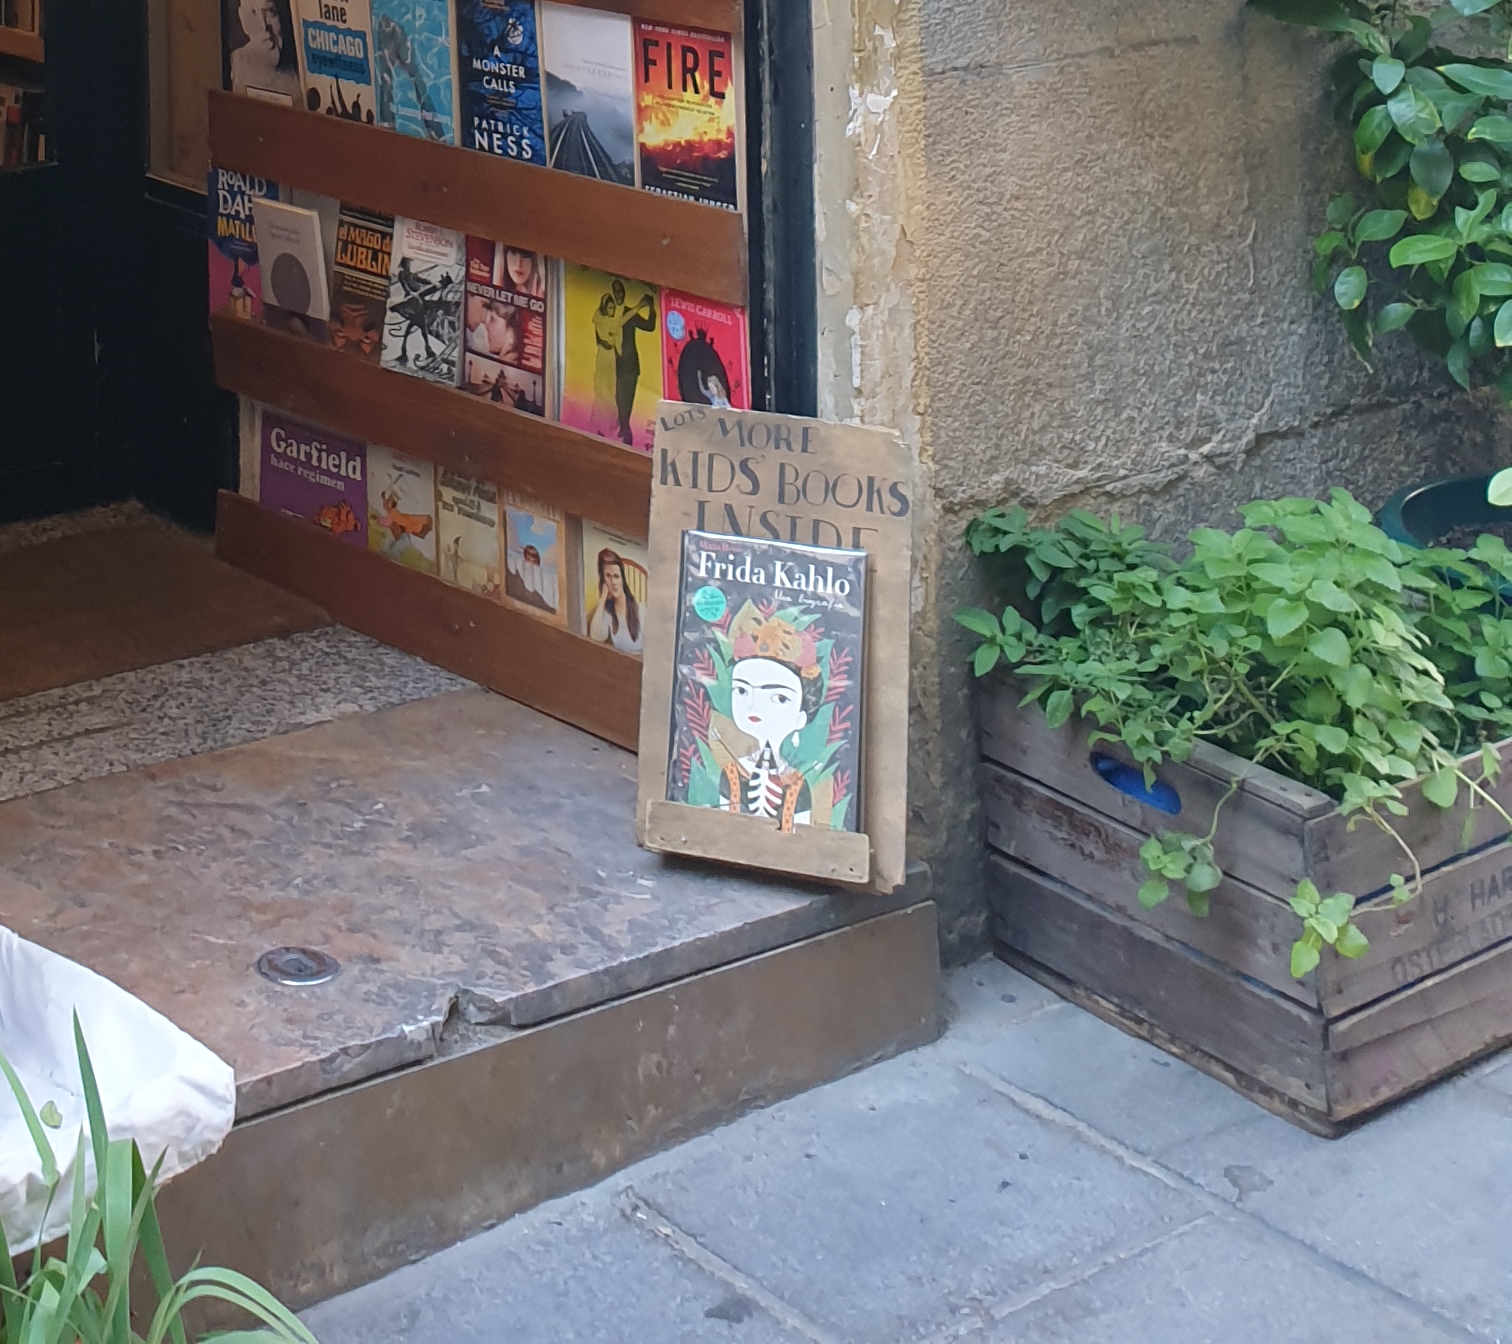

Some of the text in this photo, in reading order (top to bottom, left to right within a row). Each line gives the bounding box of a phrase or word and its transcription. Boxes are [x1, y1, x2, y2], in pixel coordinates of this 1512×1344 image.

[307, 29, 365, 59] CHICAGO
[493, 45, 501, 57] A
[472, 57, 526, 79] MONSTER
[642, 37, 727, 101] FIRE
[482, 77, 516, 94] CALLS
[473, 116, 530, 137] PATRICK
[474, 130, 533, 160] NESS
[217, 167, 267, 197] ROALD
[348, 225, 381, 251] MAGO
[404, 228, 455, 250] STEVENSON
[466, 280, 545, 313] NEVER LET ME GO
[669, 295, 733, 326] LEWIS CARROLL
[713, 416, 817, 454] MORE
[270, 427, 363, 482] Garfield
[270, 453, 296, 474] hace
[658, 446, 911, 518] KIDS' BOOKS
[698, 550, 852, 597] Frida Kahlo
